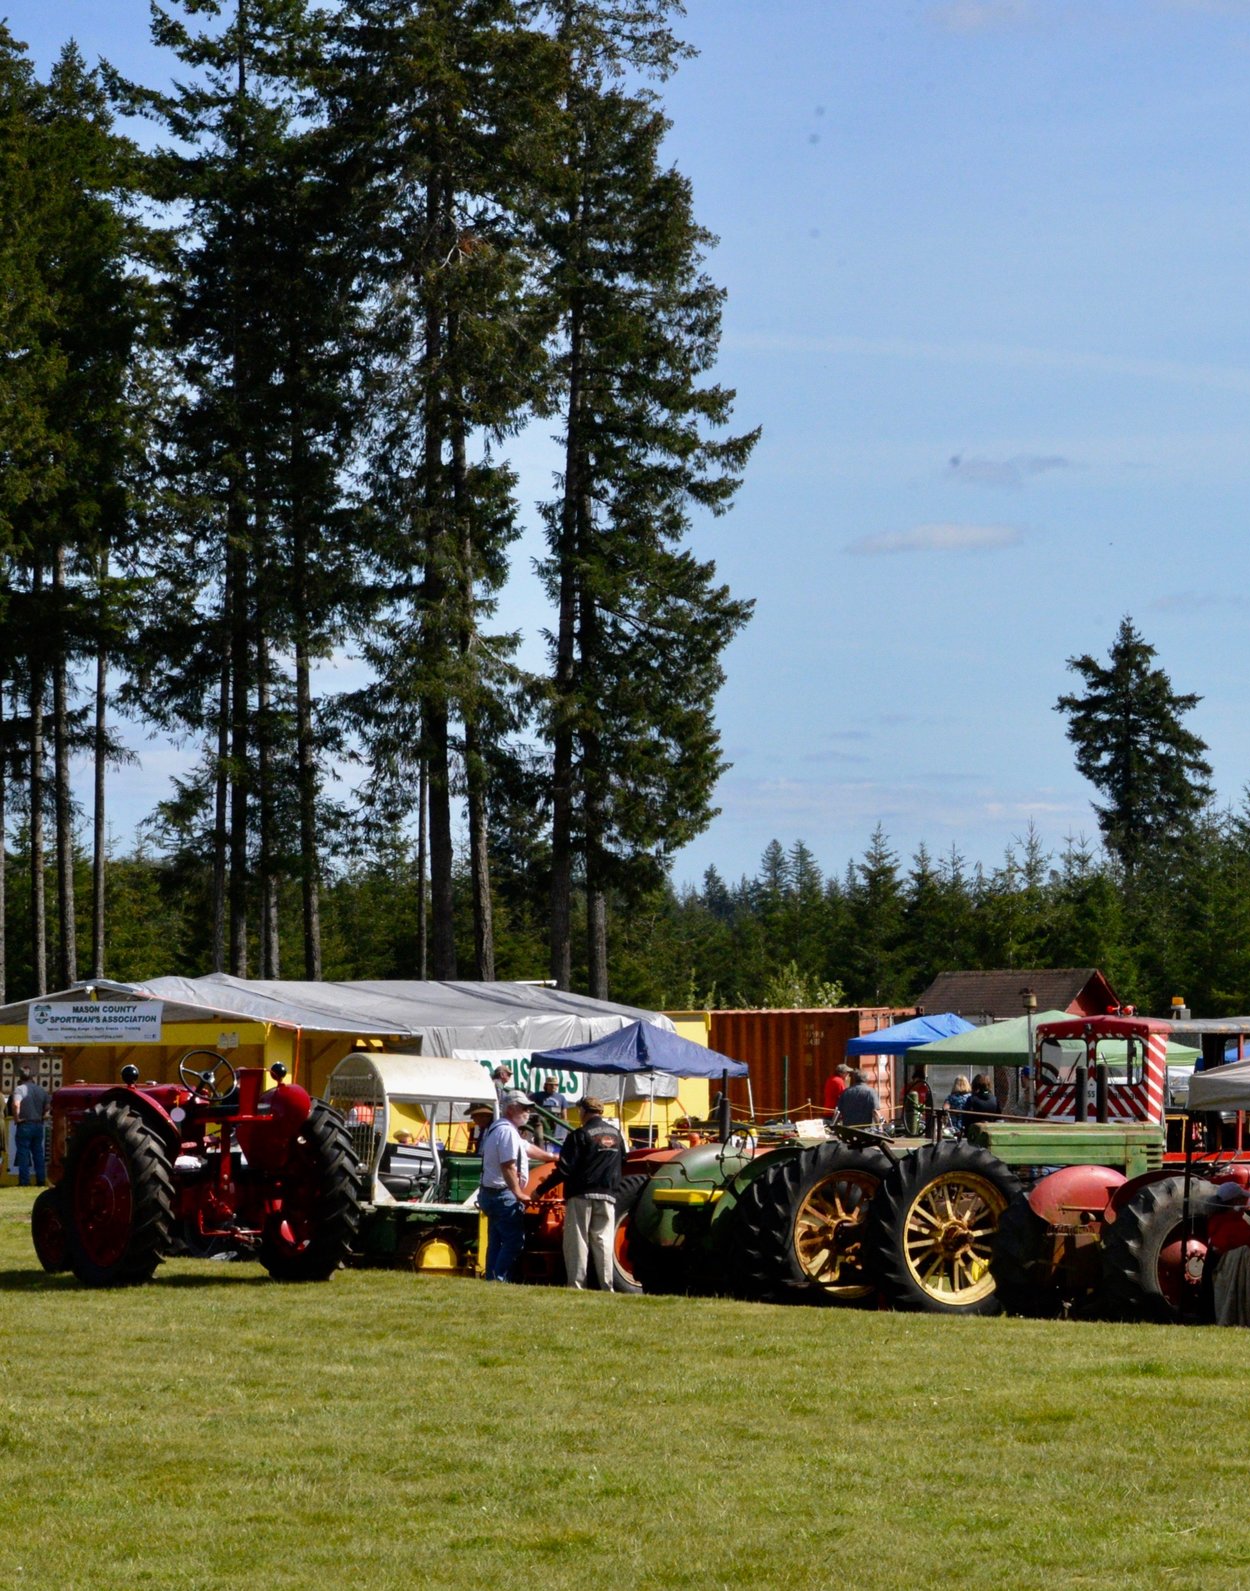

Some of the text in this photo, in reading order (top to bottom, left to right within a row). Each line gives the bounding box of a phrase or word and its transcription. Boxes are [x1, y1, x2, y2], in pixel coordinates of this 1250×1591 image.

[72, 1005, 137, 1013] MASON COUNTY
[50, 1015, 157, 1024] SPORTMAN'S ASSOCIATION
[501, 1058, 578, 1094] ISTLS
